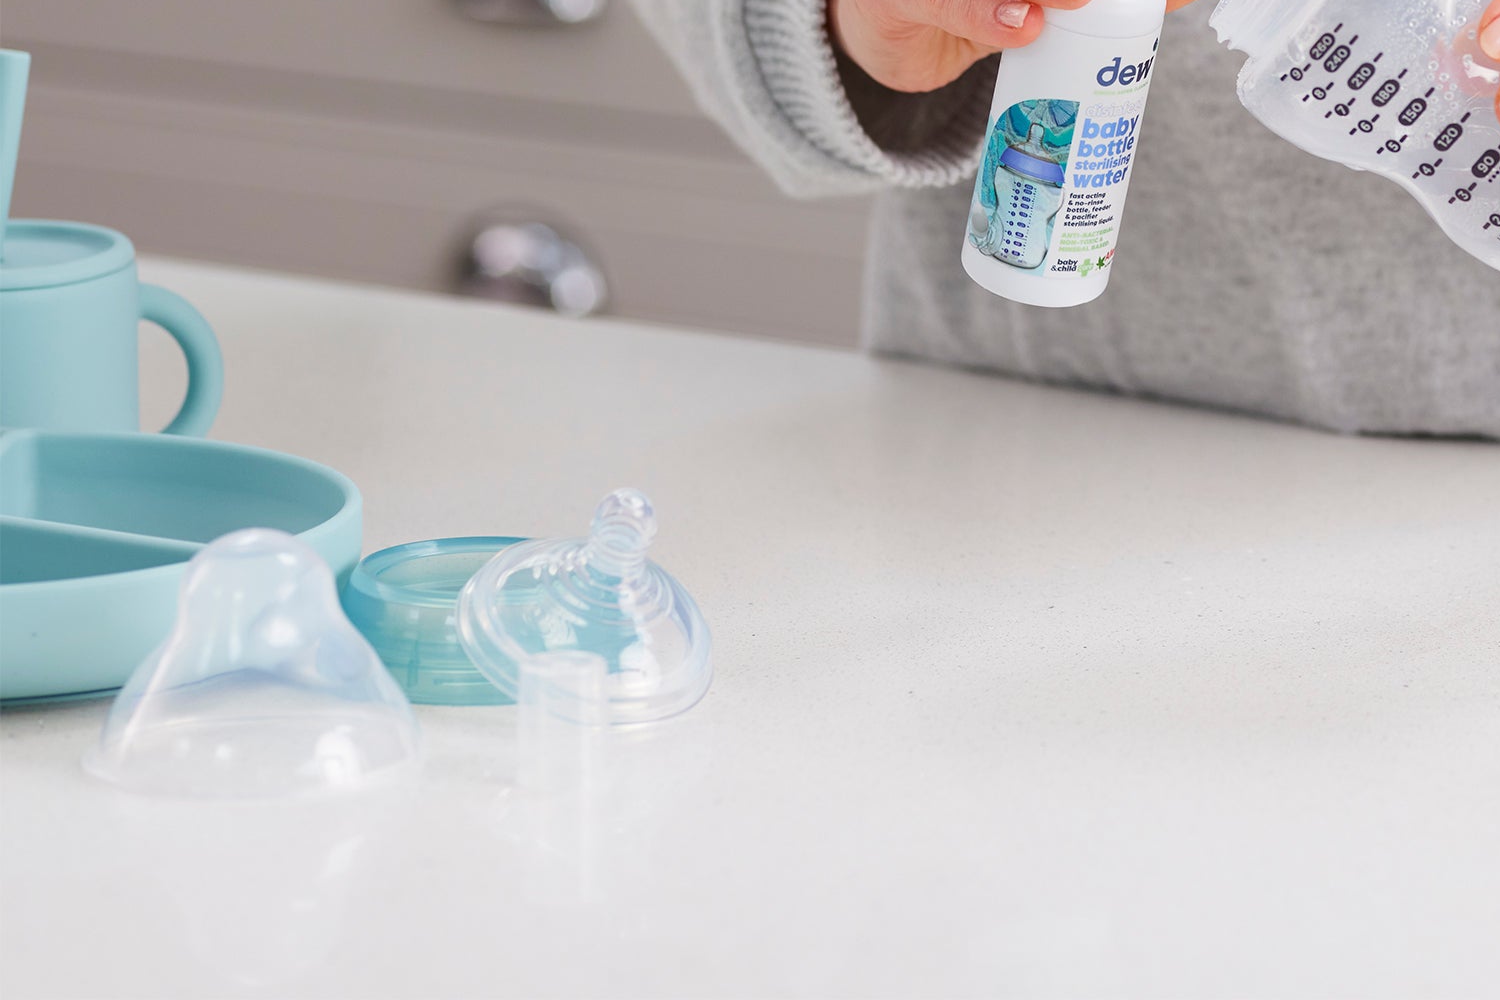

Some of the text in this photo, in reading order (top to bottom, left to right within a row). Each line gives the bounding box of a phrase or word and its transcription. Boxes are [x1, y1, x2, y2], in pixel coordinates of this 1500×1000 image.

[1311, 36, 1333, 59] 260
[1325, 48, 1348, 71] 240
[1096, 56, 1154, 87] dew
[1350, 66, 1372, 88] 210
[1373, 83, 1397, 105] 180
[1401, 101, 1424, 123] 150
[1081, 114, 1139, 139] baby
[1436, 126, 1460, 148] 120
[1077, 136, 1134, 158] bottle
[1075, 153, 1131, 171] sterilising
[1476, 154, 1496, 174] 90
[1073, 166, 1128, 188] water
[1092, 204, 1112, 212] feeder
[1057, 259, 1078, 267] baby
